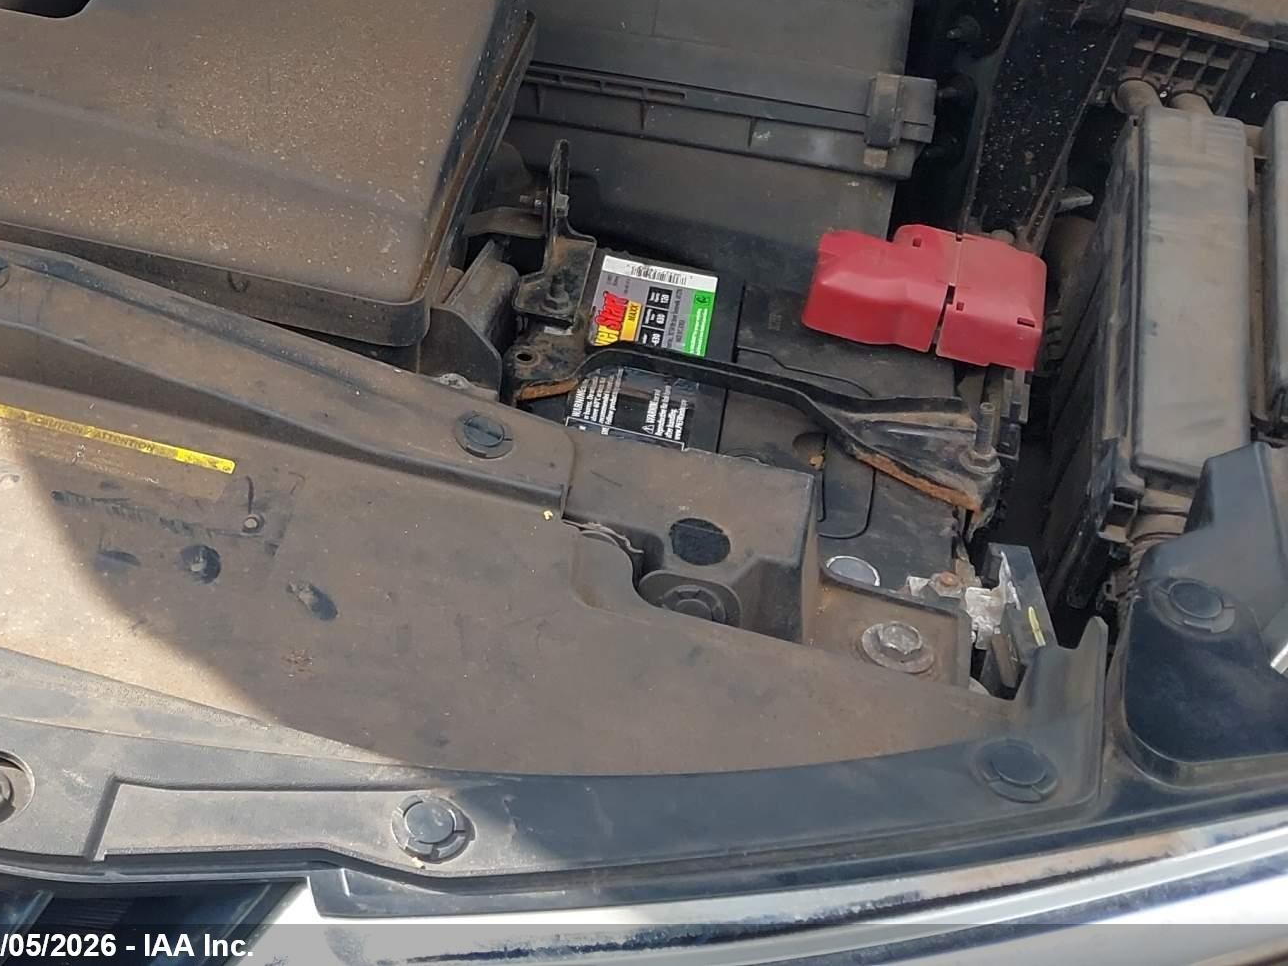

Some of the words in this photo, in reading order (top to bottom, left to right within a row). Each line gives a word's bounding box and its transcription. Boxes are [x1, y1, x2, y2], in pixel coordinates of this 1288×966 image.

[594, 291, 629, 346] verStart
[628, 304, 639, 321] MAXX
[94, 430, 155, 452] ATTENTION
